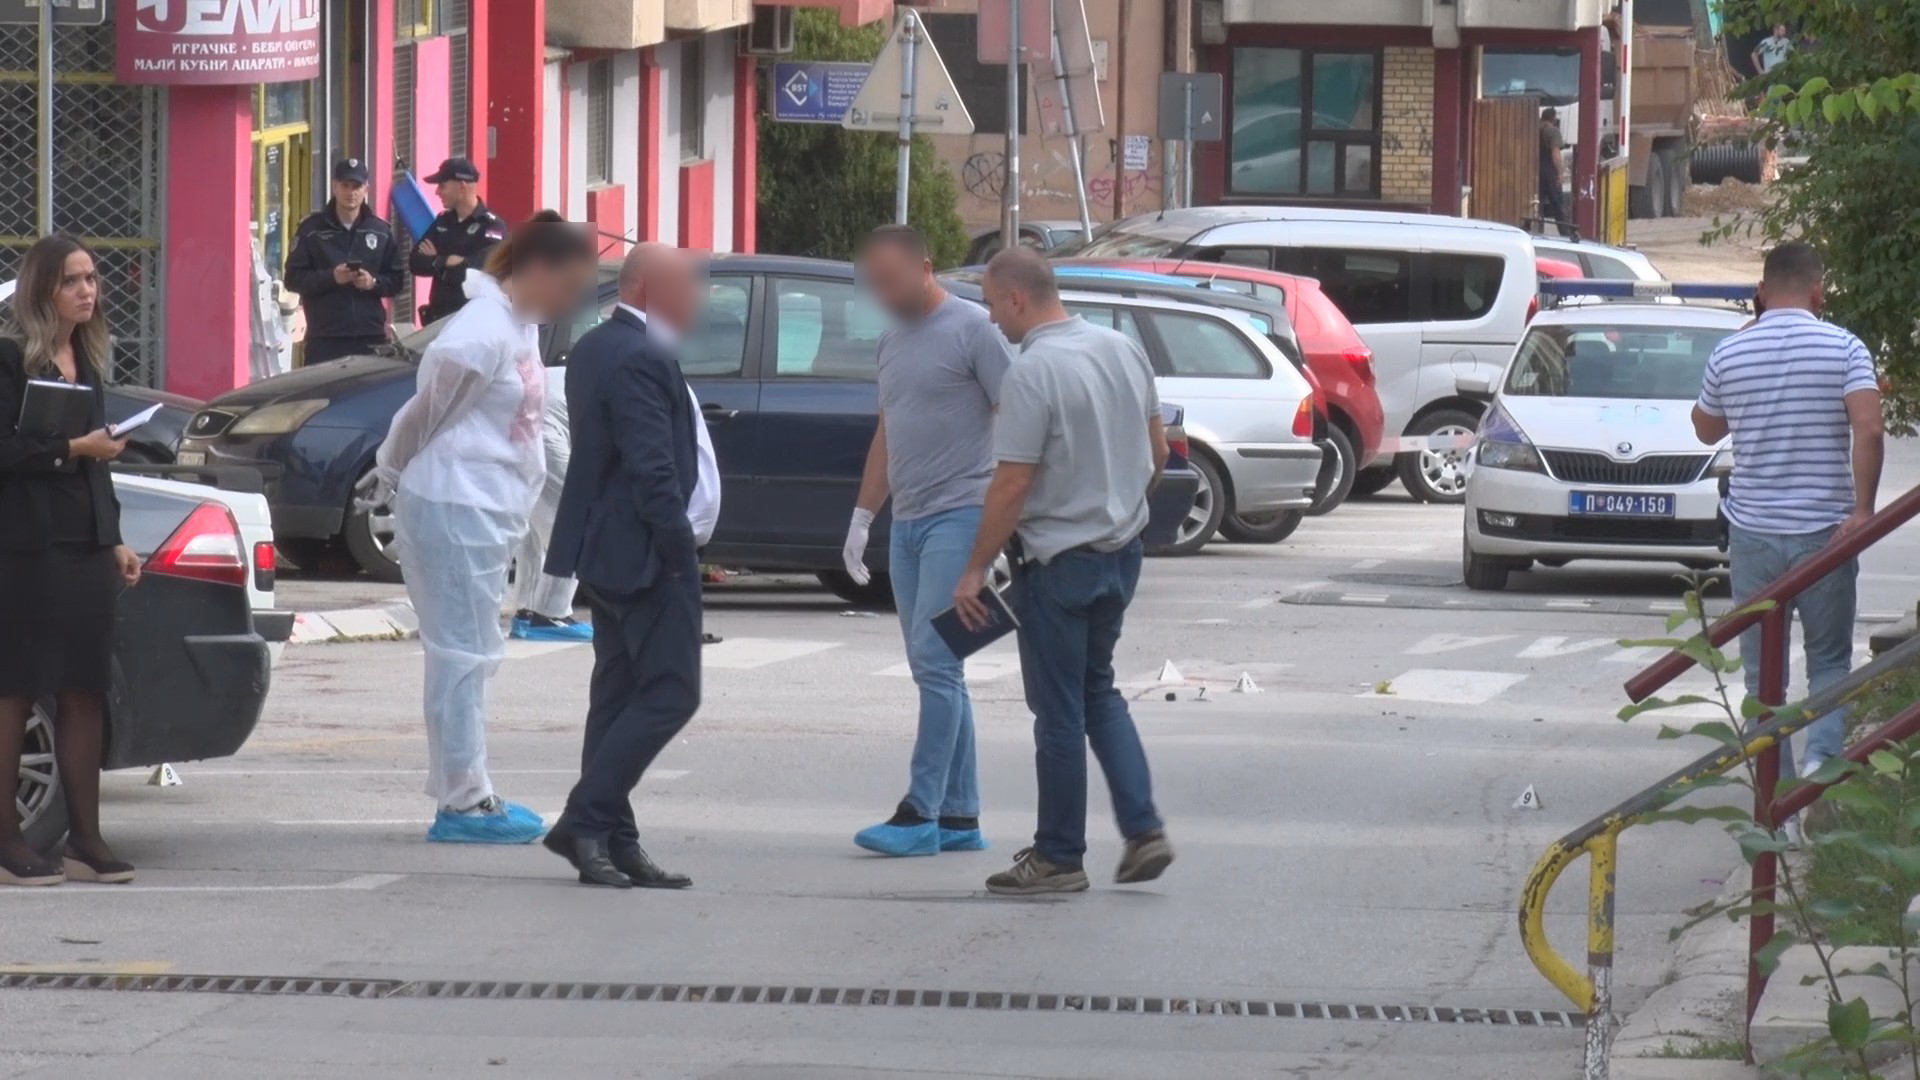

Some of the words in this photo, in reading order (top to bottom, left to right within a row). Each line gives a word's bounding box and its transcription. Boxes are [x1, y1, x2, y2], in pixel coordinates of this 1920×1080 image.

[171, 42, 238, 55] ИГРАЧКЕ
[252, 41, 283, 54] БЕБИ
[134, 58, 176, 71] МАЛИ
[179, 58, 229, 72] КУЋНИ
[231, 56, 286, 71] АПАРАТИ
[1585, 494, 1595, 512] П
[166, 768, 173, 780] 8
[1523, 792, 1532, 804] 9
